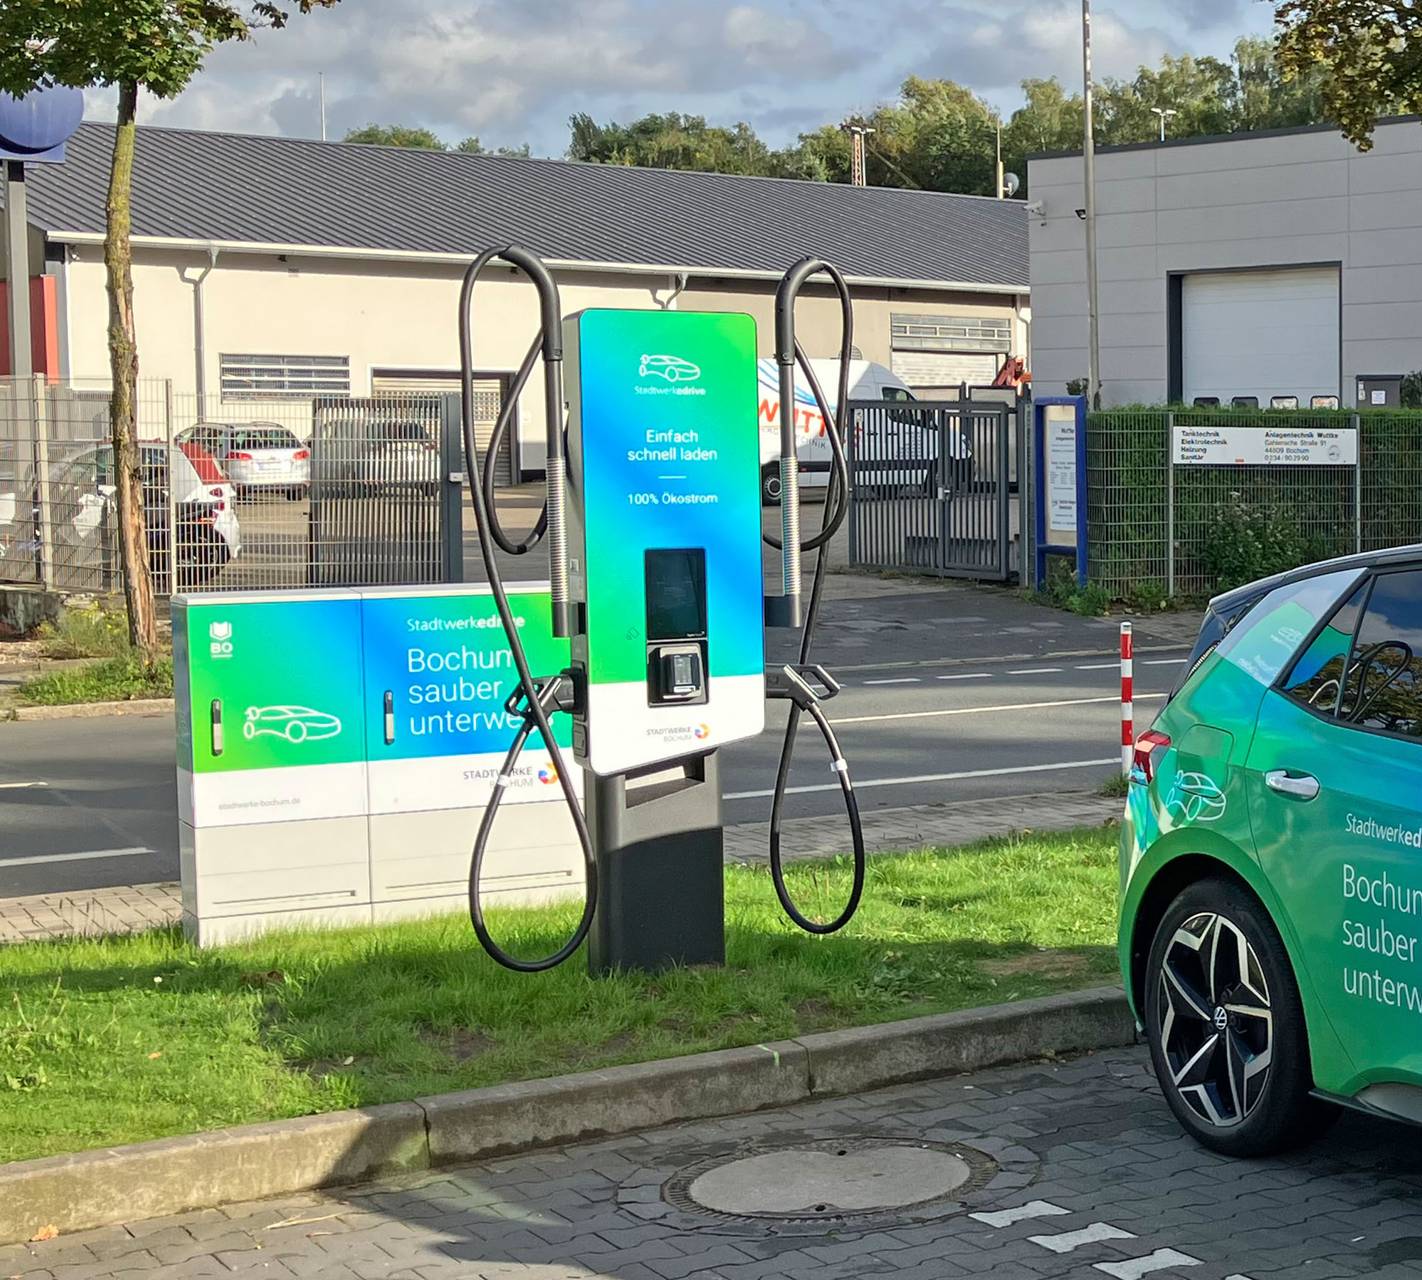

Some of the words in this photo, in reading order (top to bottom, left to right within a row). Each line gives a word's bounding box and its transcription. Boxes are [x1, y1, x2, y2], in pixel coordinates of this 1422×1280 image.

[645, 428, 699, 443] Einfach
[627, 447, 677, 461] schnell
[680, 447, 718, 461] laden
[627, 493, 659, 505] 100%
[661, 491, 718, 504] Ökostrom
[210, 642, 233, 653] BO
[408, 677, 503, 704] sauber
[1342, 918, 1418, 962] sauber
